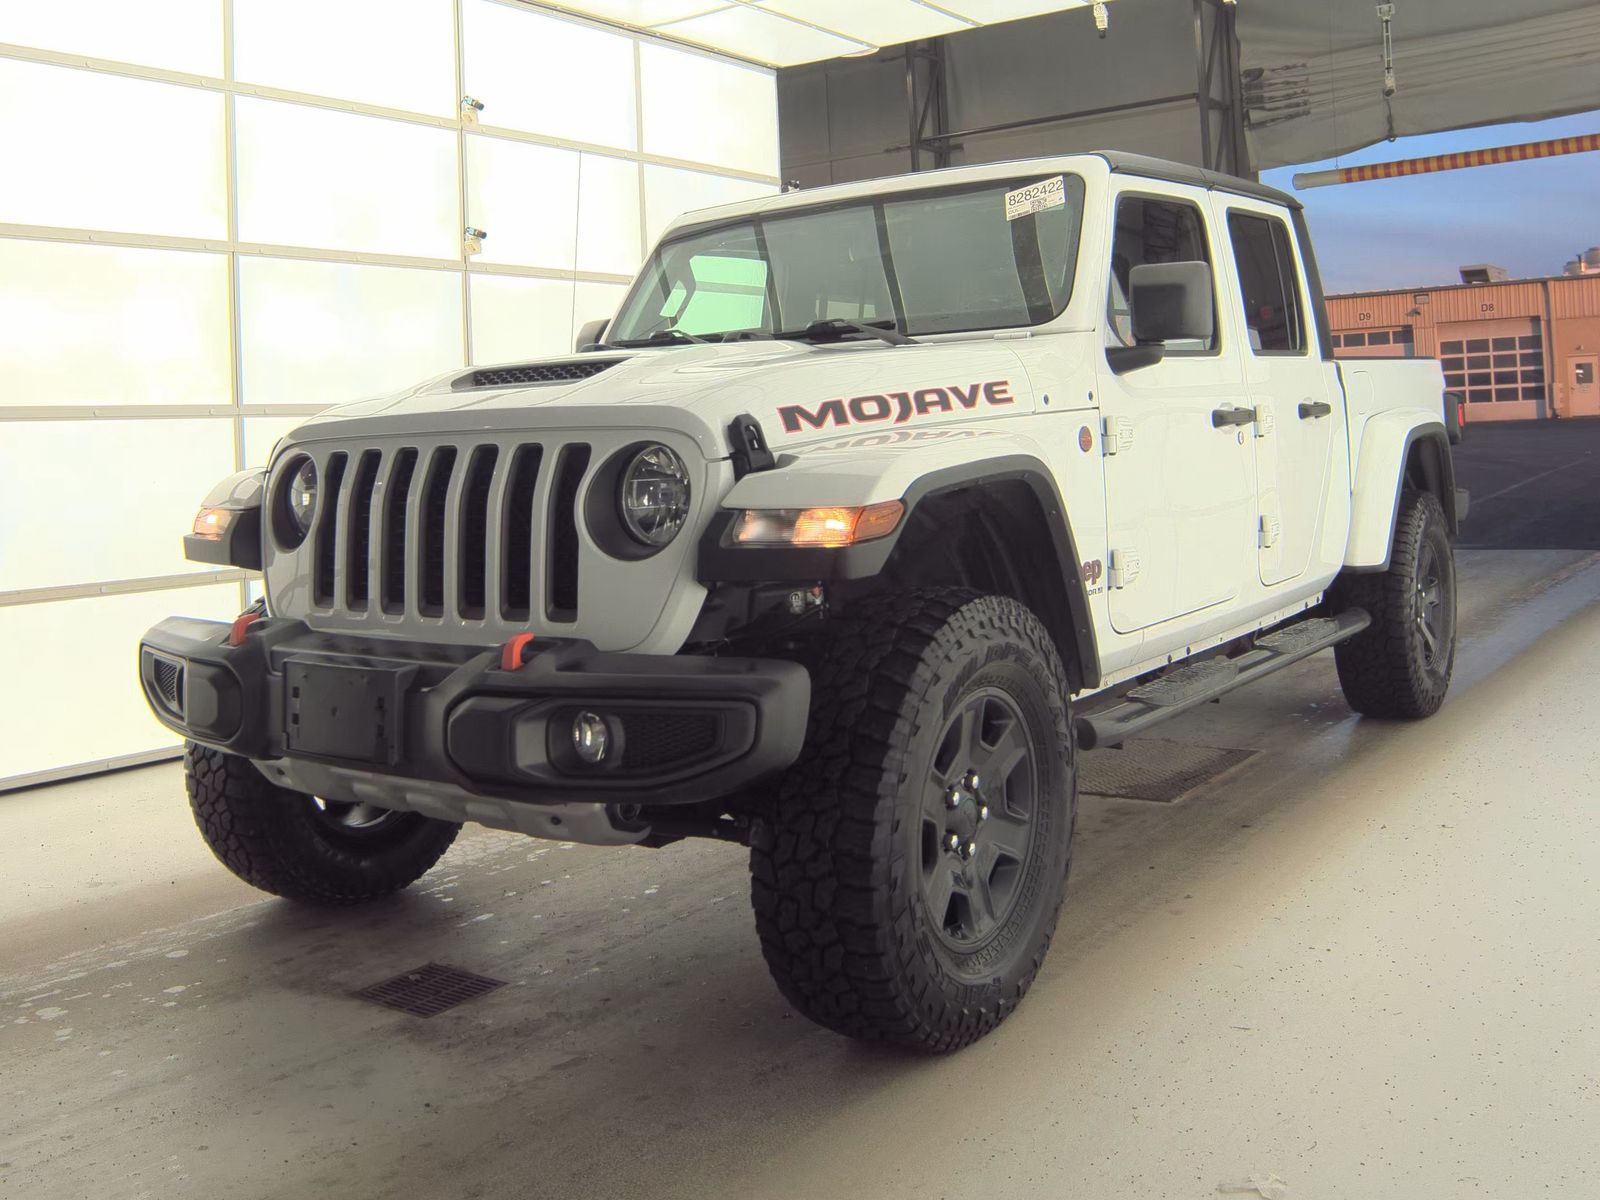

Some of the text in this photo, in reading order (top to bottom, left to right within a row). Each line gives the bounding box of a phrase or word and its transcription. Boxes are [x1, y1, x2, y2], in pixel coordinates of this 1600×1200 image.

[1008, 179, 1063, 206] 8282422
[1359, 313, 1371, 321] D9
[1481, 303, 1495, 312] D8
[776, 380, 1015, 434] MOJAVE
[1082, 559, 1102, 585] ep
